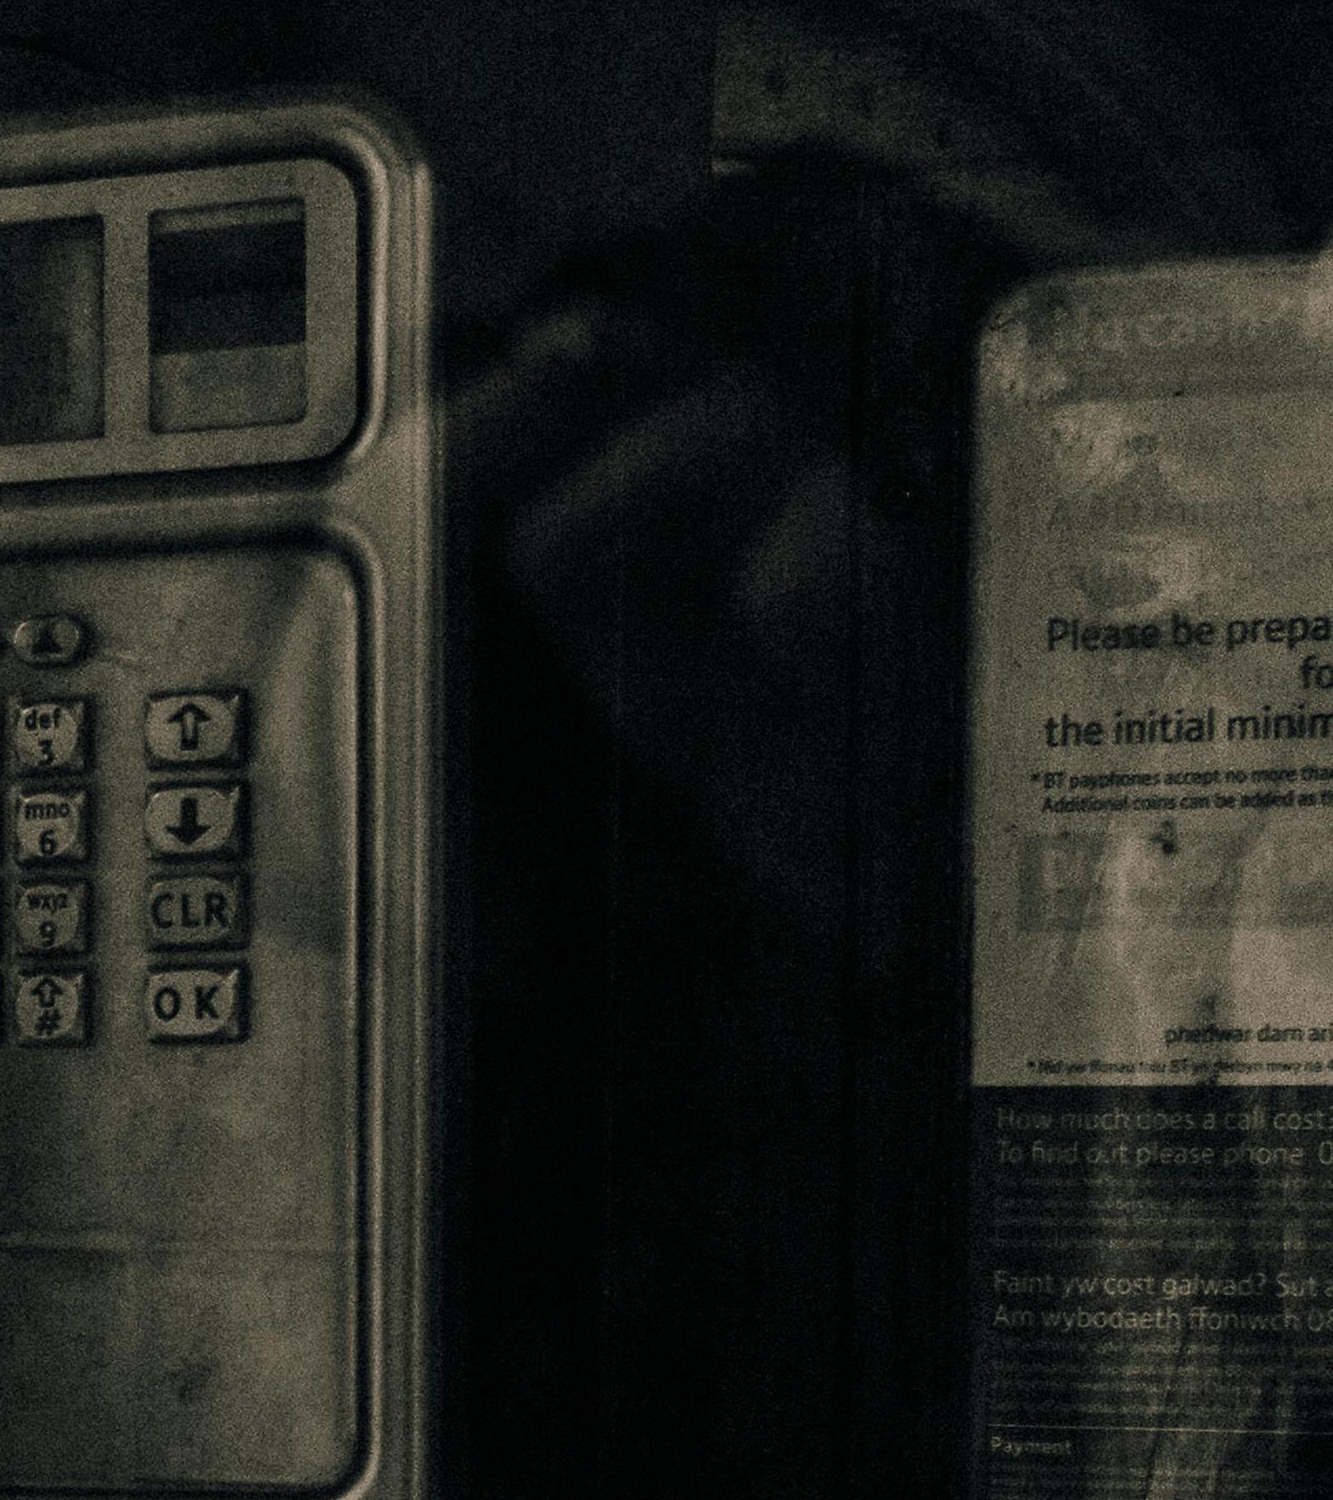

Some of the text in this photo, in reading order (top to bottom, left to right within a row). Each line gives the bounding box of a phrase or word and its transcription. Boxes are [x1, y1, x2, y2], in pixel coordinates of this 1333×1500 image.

[1046, 617, 1160, 652] Please
[1172, 614, 1216, 648] be
[24, 708, 61, 730] def
[1044, 712, 1104, 747] the
[1113, 706, 1215, 744] initial
[38, 739, 54, 766] 3
[1069, 770, 1160, 790] payphones
[1163, 770, 1220, 788] accept
[1225, 770, 1248, 784] no
[1251, 769, 1297, 783] more
[24, 801, 71, 820] mno
[1041, 795, 1129, 813] Additional
[1132, 796, 1177, 811] coins
[1179, 796, 1210, 810] can
[1214, 792, 1236, 808] be
[1240, 790, 1295, 808] added
[1298, 793, 1316, 807] as
[38, 829, 57, 856] 6
[26, 893, 69, 915] wxyz
[151, 892, 229, 929] CLR
[38, 920, 56, 947] 9
[153, 985, 220, 1021] OK
[997, 1107, 1054, 1130] How
[1061, 1106, 1131, 1131] much
[1201, 1111, 1216, 1130] a
[1223, 1104, 1267, 1130] call
[1030, 1139, 1079, 1164] find
[1086, 1143, 1129, 1165] out
[1136, 1141, 1216, 1167] please
[1222, 1142, 1306, 1167] phone
[993, 1269, 1055, 1295] Faint
[1061, 1274, 1099, 1299] yw
[1103, 1274, 1157, 1297] cost
[1161, 1272, 1268, 1301] galwad?
[1275, 1270, 1318, 1298] Sut
[993, 1304, 1035, 1328] Am
[1041, 1306, 1182, 1332] wybodaeth
[990, 1435, 1072, 1457] Payment
